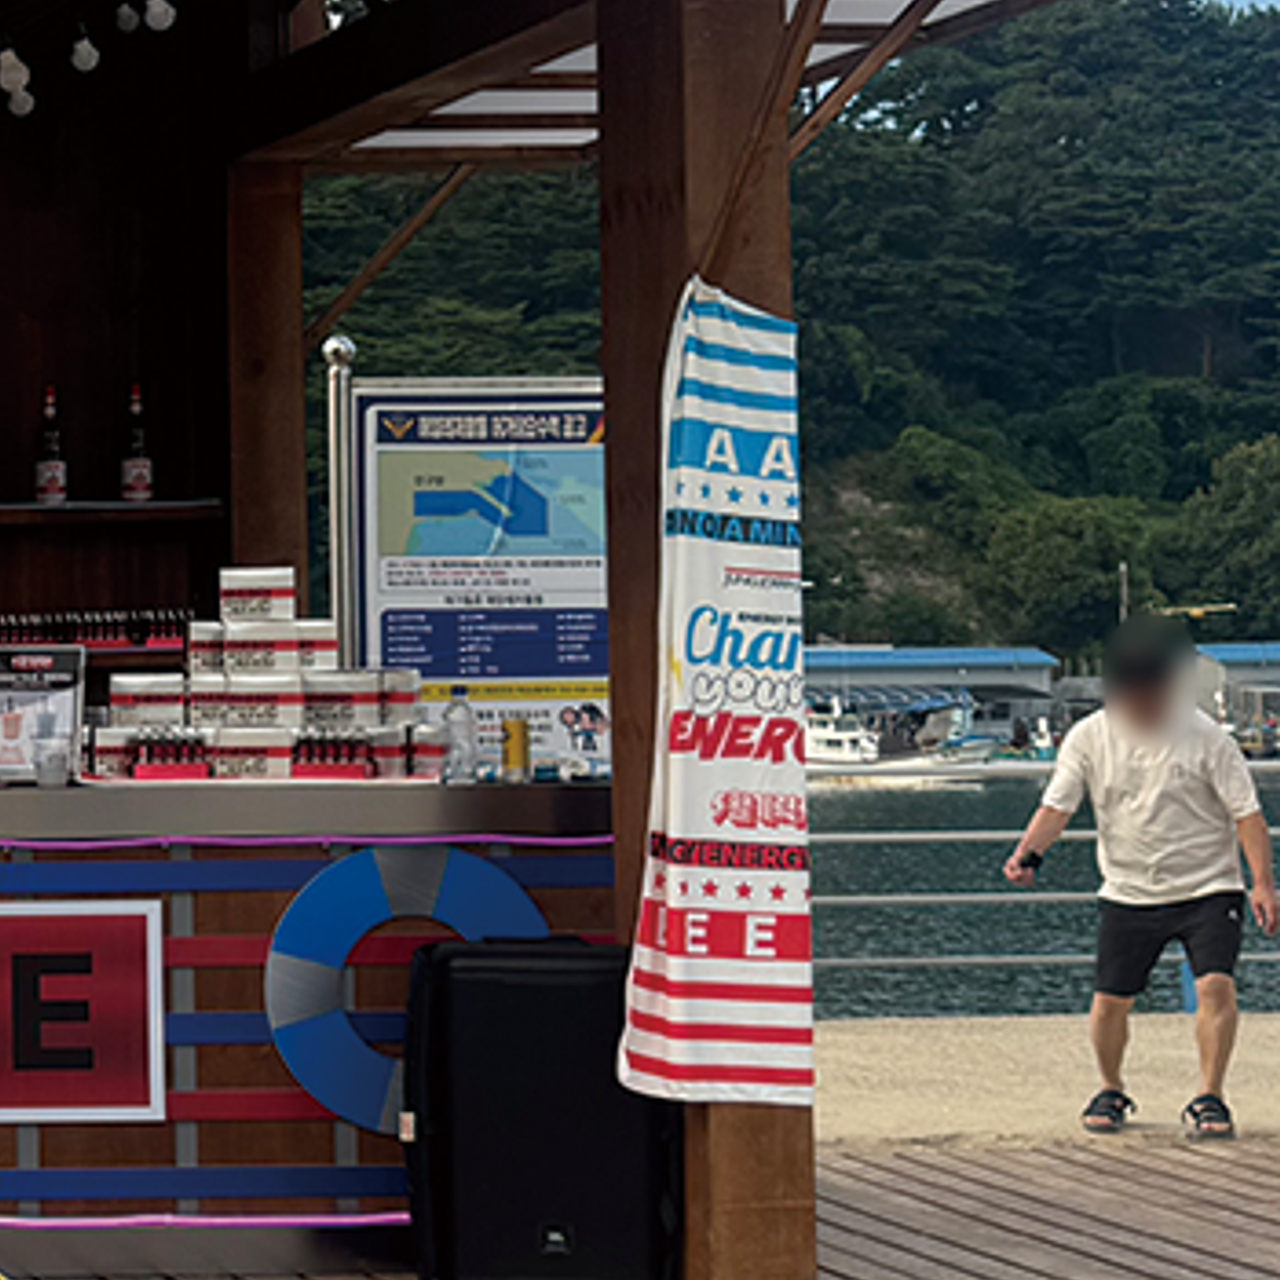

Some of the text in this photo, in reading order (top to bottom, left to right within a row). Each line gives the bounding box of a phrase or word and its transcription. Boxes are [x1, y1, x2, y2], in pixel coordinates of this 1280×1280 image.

[705, 428, 739, 473] A
[704, 841, 811, 869] ENERG
[746, 915, 777, 957] E
[11, 953, 94, 1069] E
